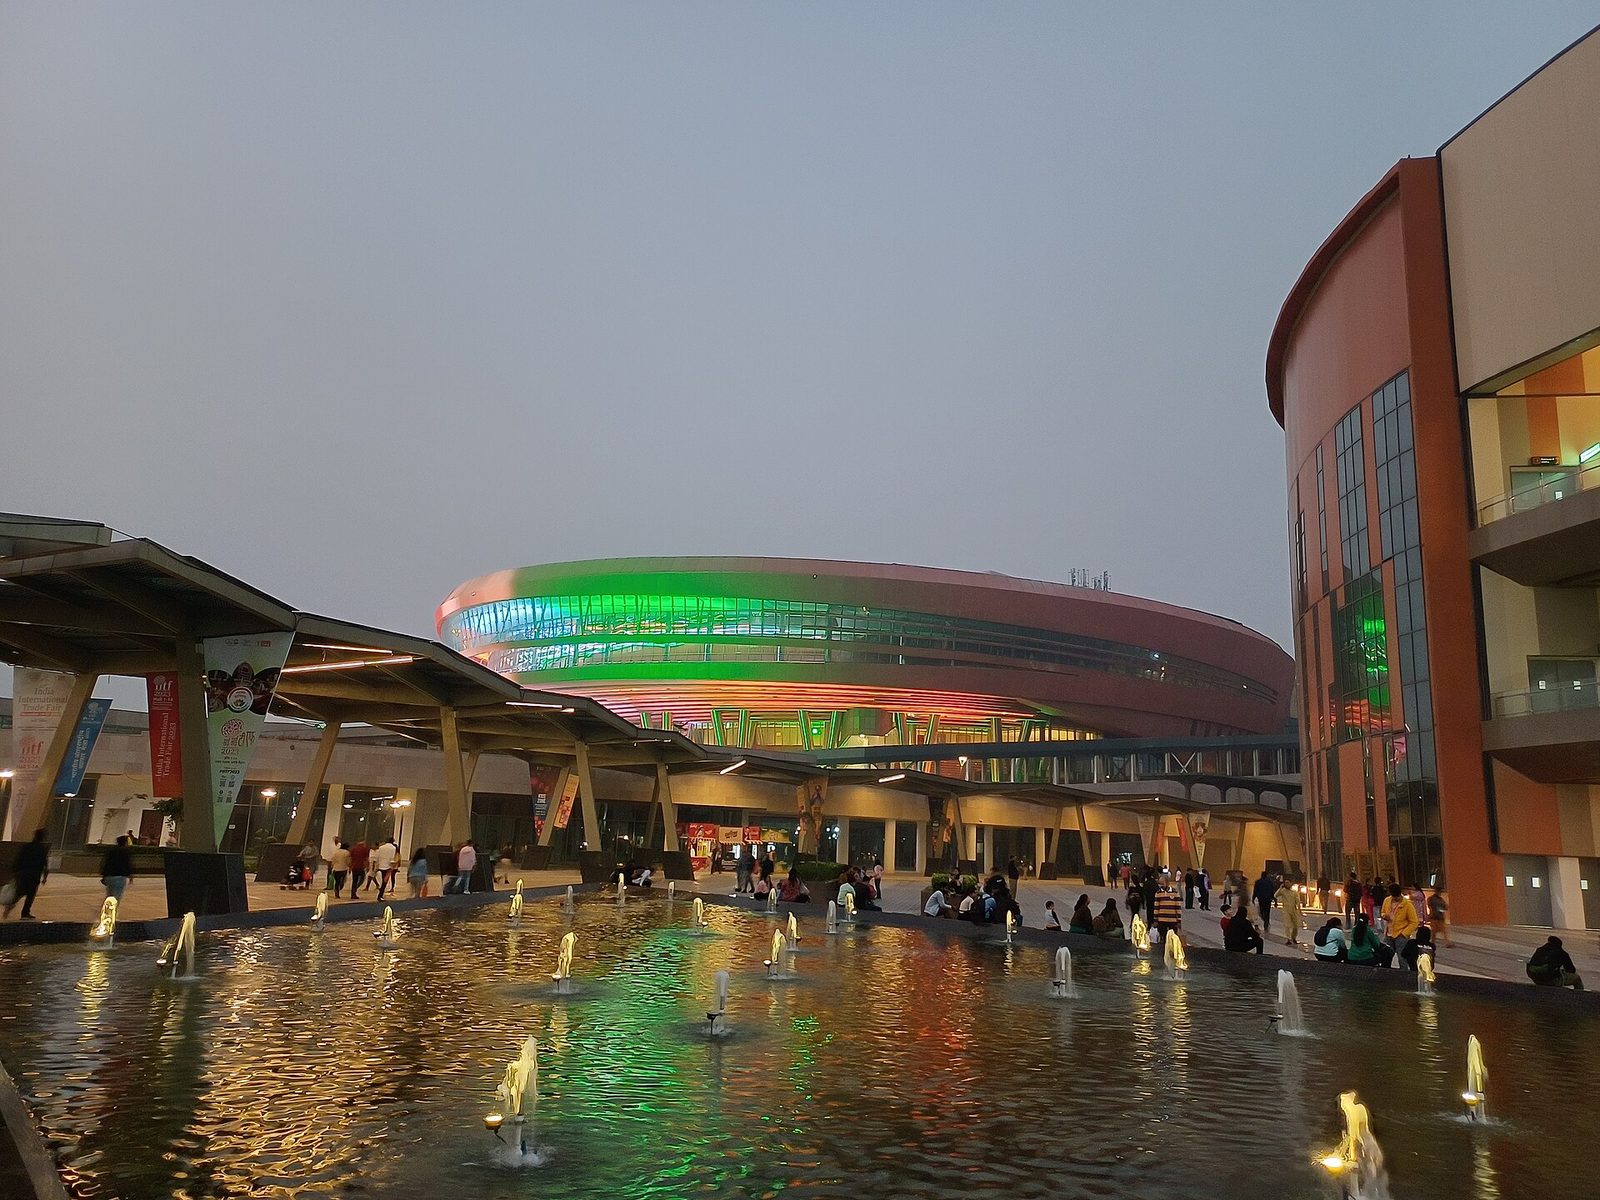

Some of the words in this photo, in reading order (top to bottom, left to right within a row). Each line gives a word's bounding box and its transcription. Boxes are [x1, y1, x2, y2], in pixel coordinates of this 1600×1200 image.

[34, 687, 54, 695] India
[18, 695, 68, 704] International
[23, 703, 44, 711] Trade
[46, 703, 62, 711] Fair
[158, 712, 169, 757] International
[163, 757, 171, 776] Trade
[168, 722, 176, 741] 2023
[221, 748, 239, 756] 2023
[155, 757, 164, 777] India
